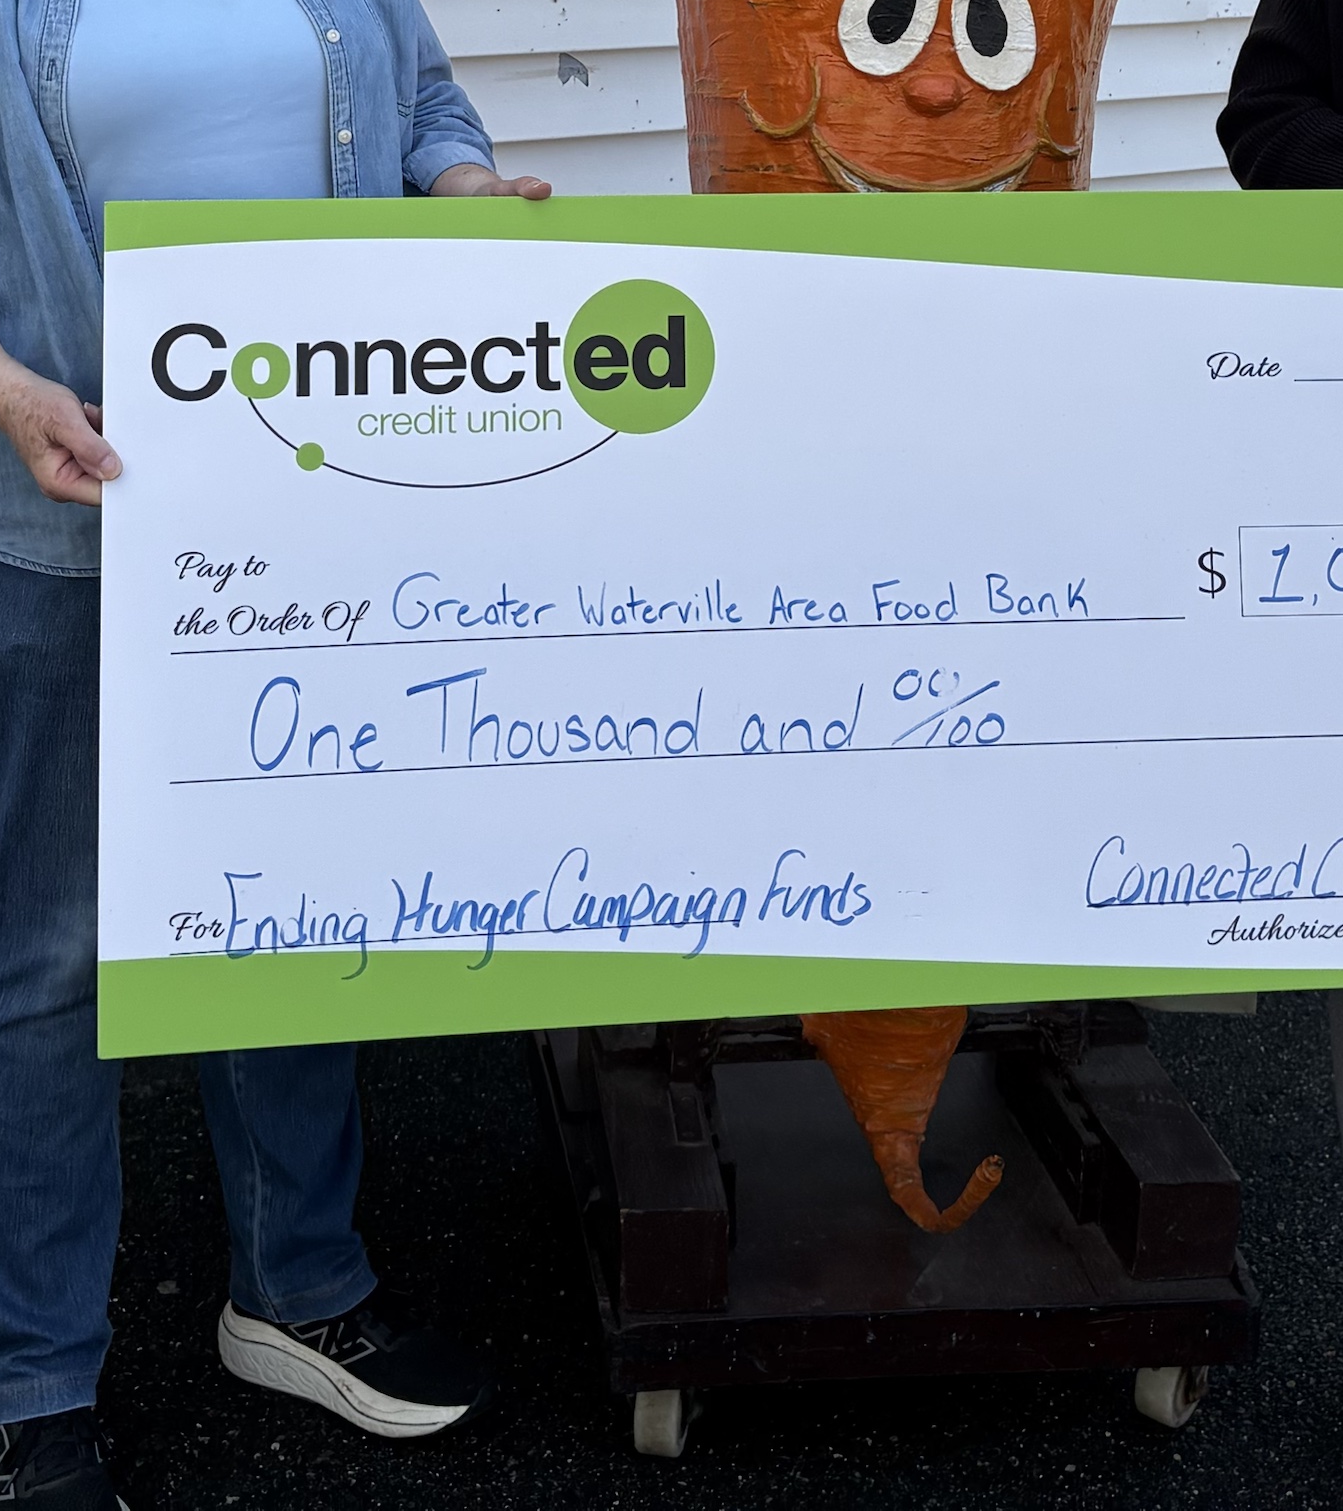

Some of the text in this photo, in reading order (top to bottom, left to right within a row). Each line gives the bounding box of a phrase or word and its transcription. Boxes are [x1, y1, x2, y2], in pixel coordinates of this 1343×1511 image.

[151, 315, 687, 401] Connected
[1206, 351, 1283, 380] Date
[357, 403, 562, 436] credit union
[174, 551, 271, 593] Pay to
[1197, 546, 1227, 600] $
[173, 599, 372, 643] the Order Of
[391, 571, 1089, 631] Greater Waterville Area Food Bank
[250, 675, 385, 773] One
[405, 666, 704, 761] Thousand
[739, 682, 865, 755] and
[1085, 834, 1308, 907] Connected
[169, 911, 225, 941] For
[222, 846, 872, 981] Ending Hunger Campaign Funds
